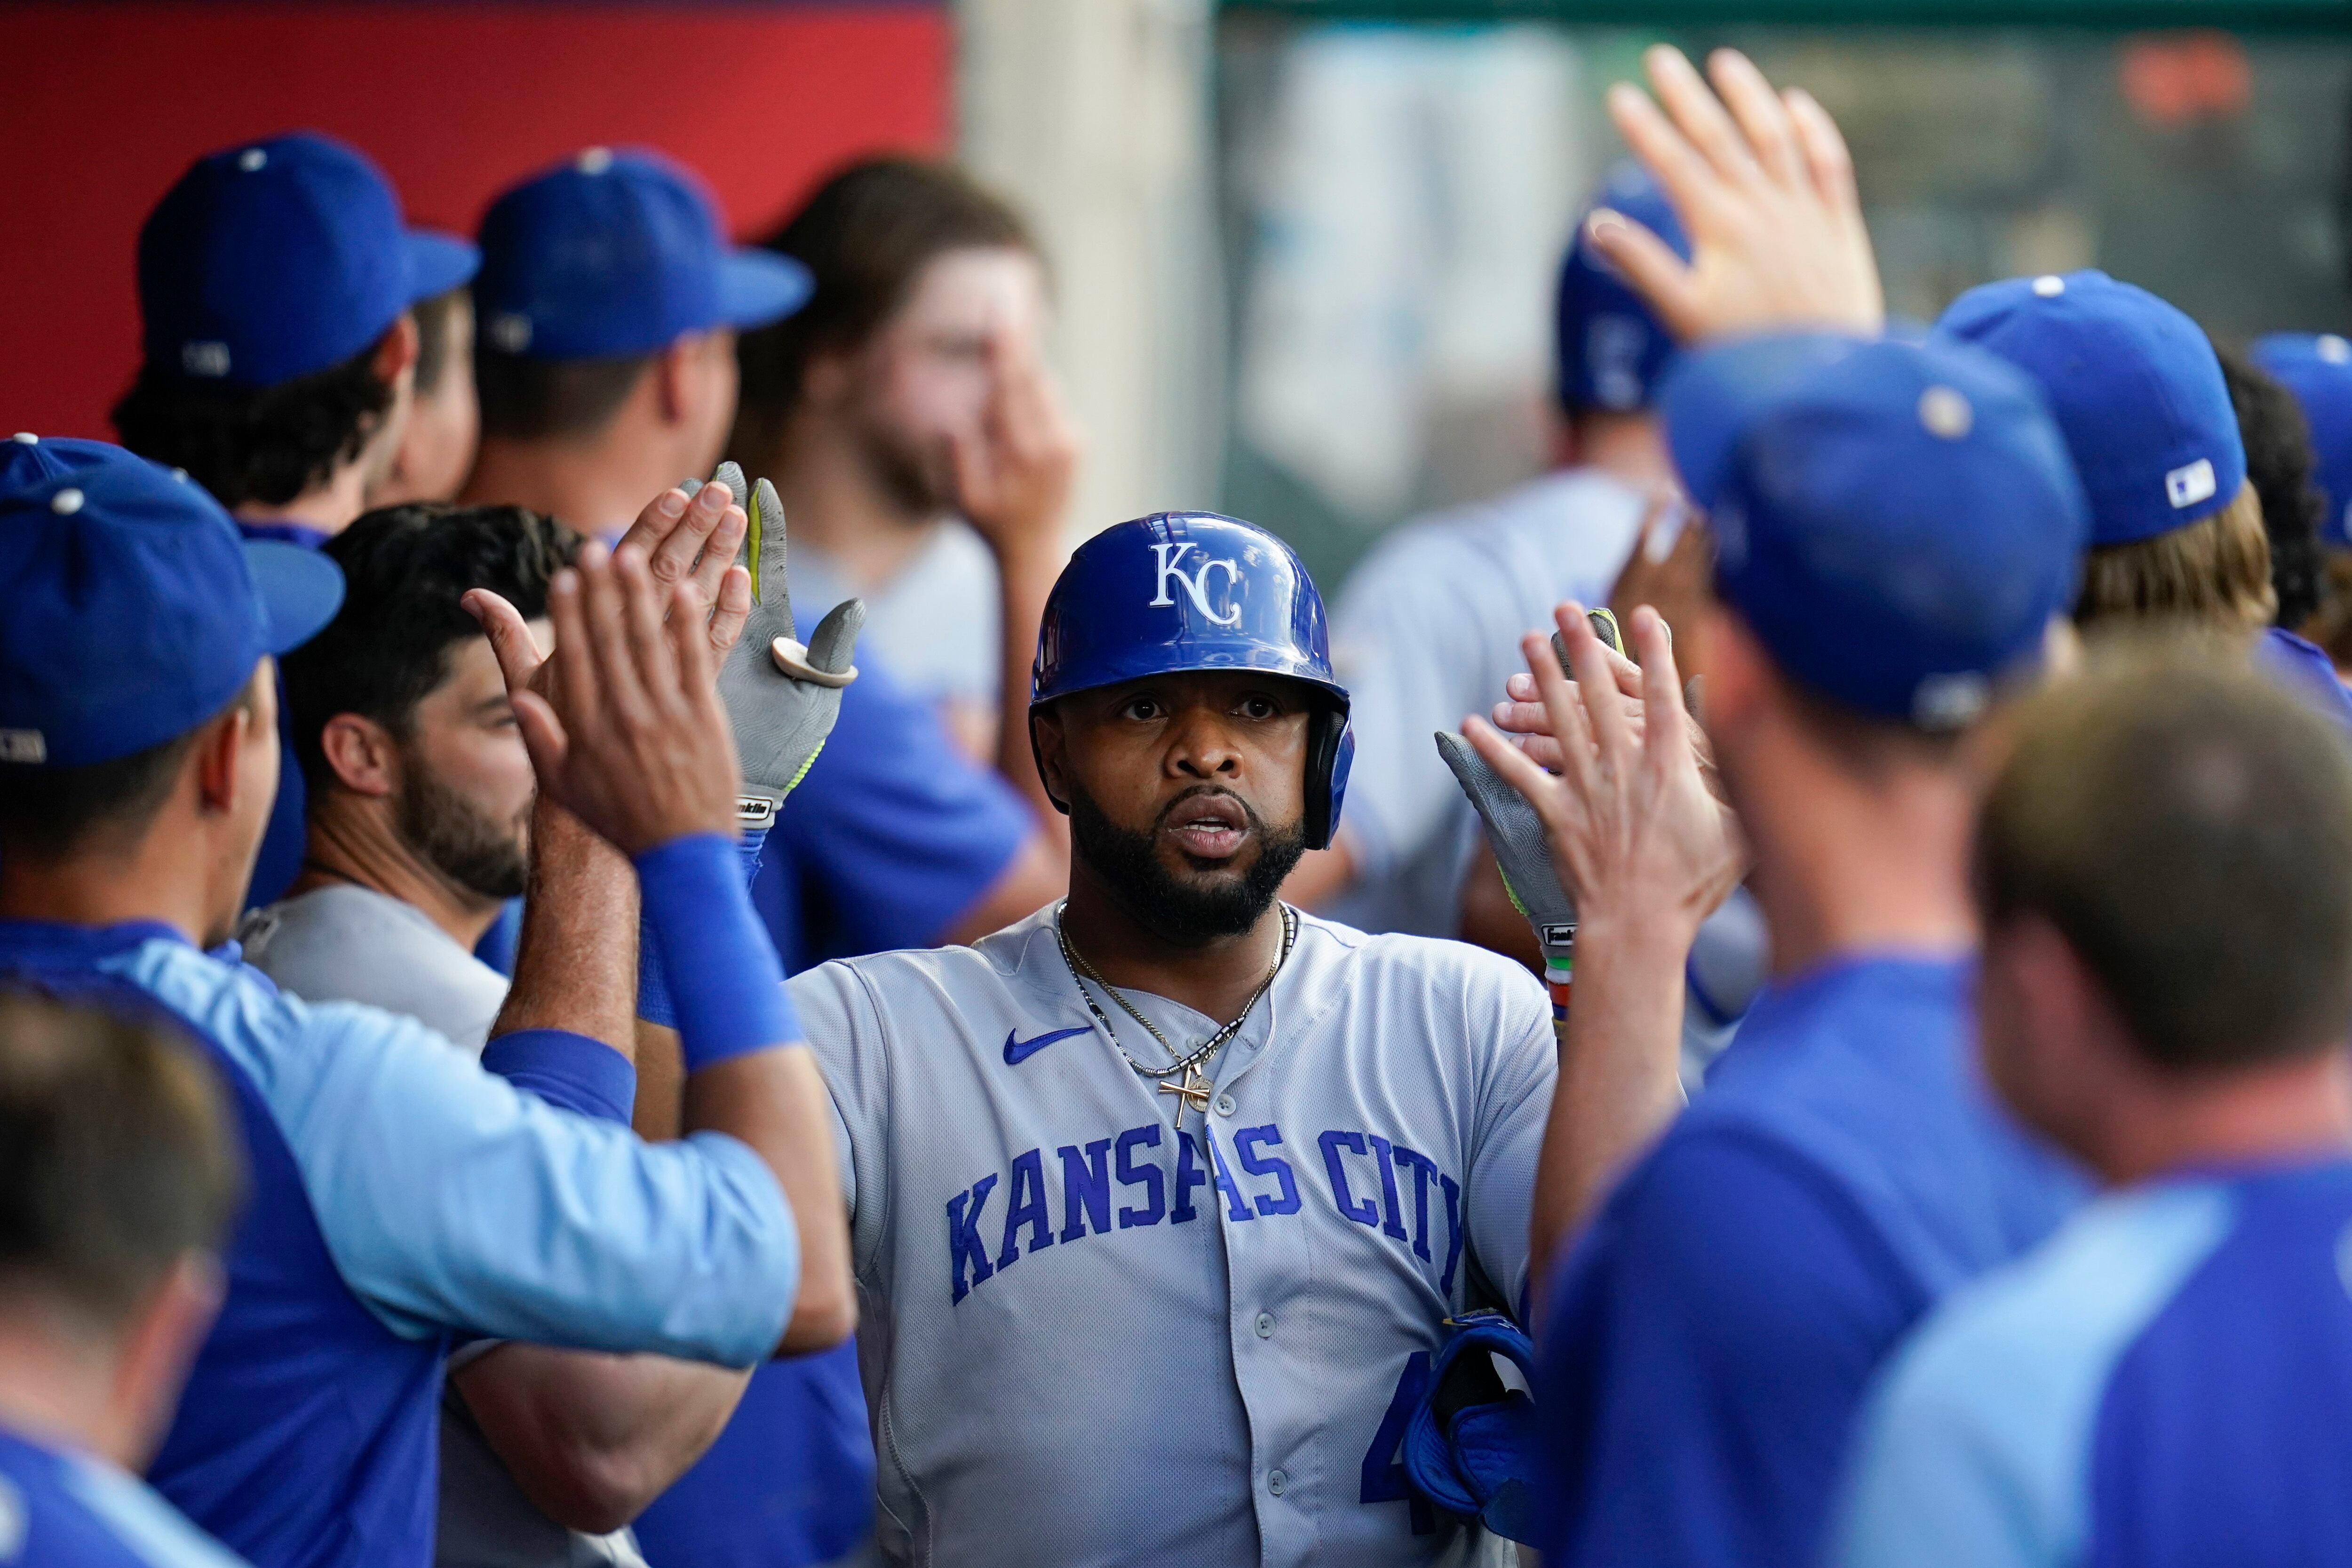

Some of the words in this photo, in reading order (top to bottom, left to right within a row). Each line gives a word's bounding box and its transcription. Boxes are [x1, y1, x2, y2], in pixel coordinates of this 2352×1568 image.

[1149, 542, 1241, 625] KC
[946, 1123, 1302, 1306] KANSAS
[1318, 1130, 1463, 1301] CITY
